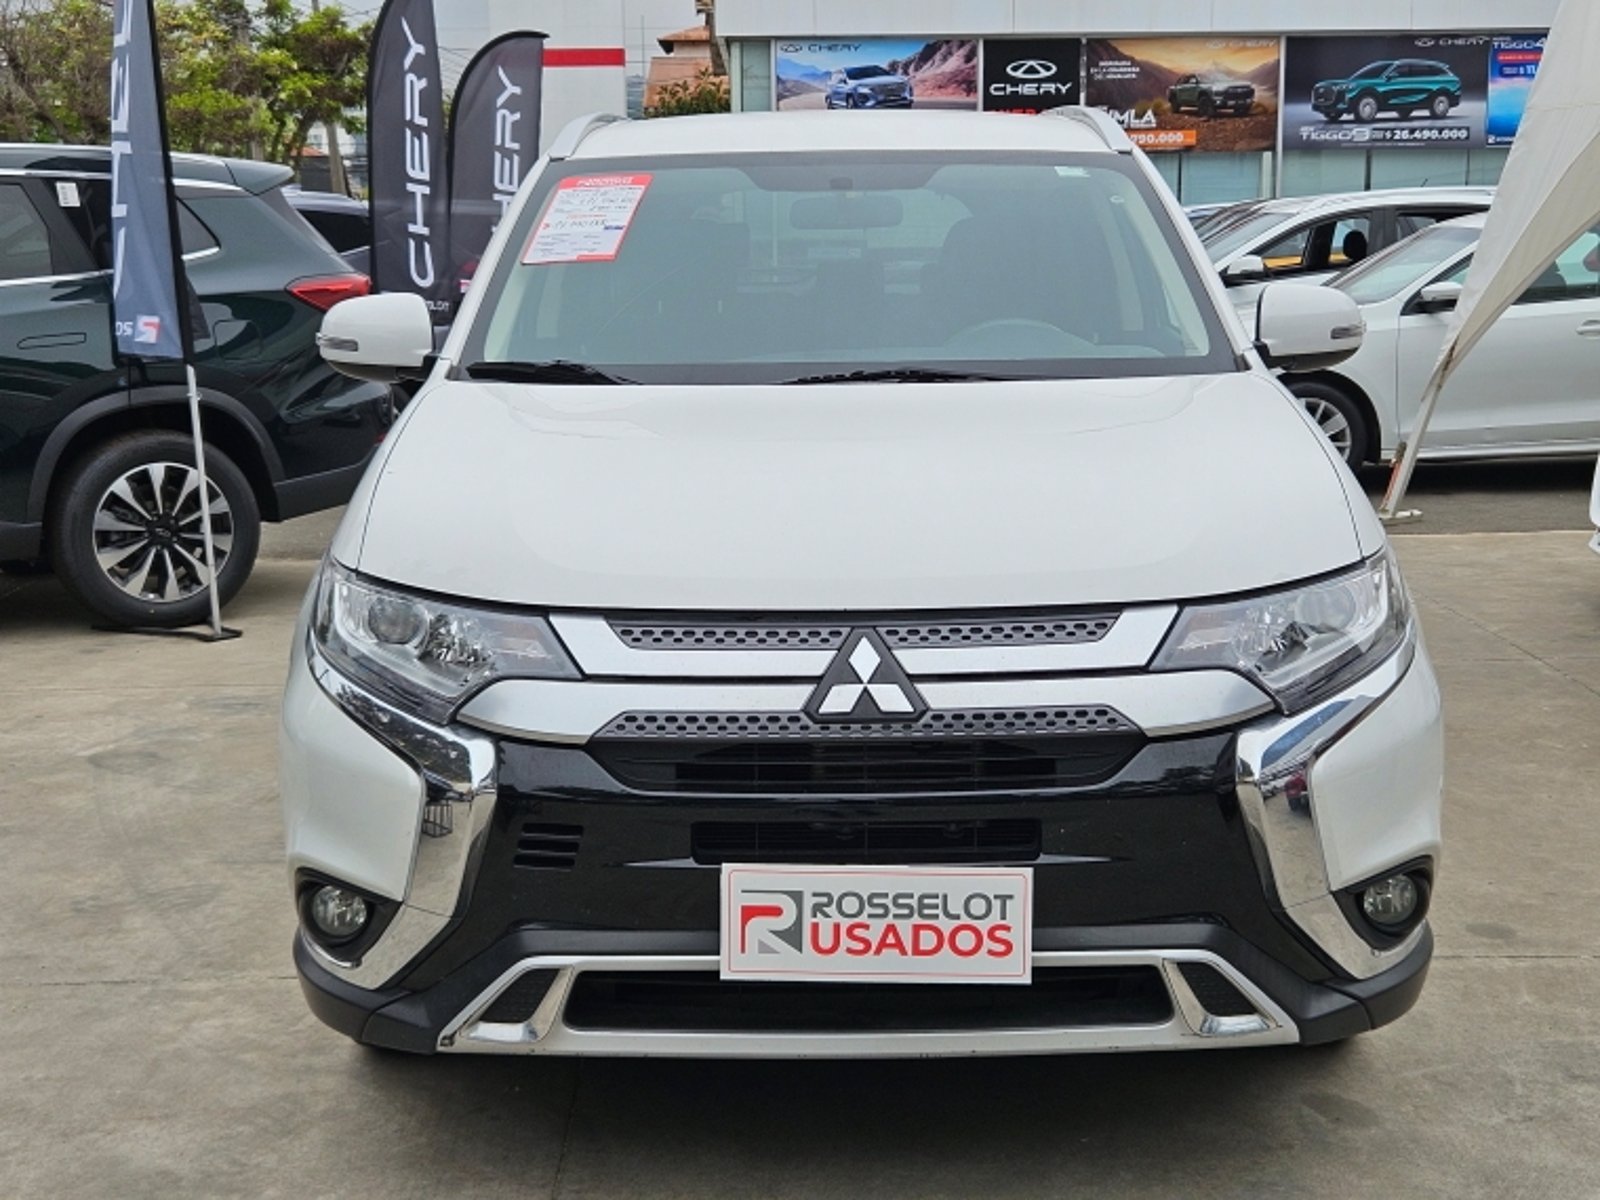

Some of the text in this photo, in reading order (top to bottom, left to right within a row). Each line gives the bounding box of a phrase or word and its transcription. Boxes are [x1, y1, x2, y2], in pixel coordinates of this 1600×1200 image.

[808, 43, 862, 52] CHERY
[989, 83, 1072, 96] CHERY
[401, 16, 435, 287] CHERY
[491, 65, 522, 234] HERY
[811, 891, 1014, 921] ROSSELOT
[810, 922, 1014, 957] USADOS
